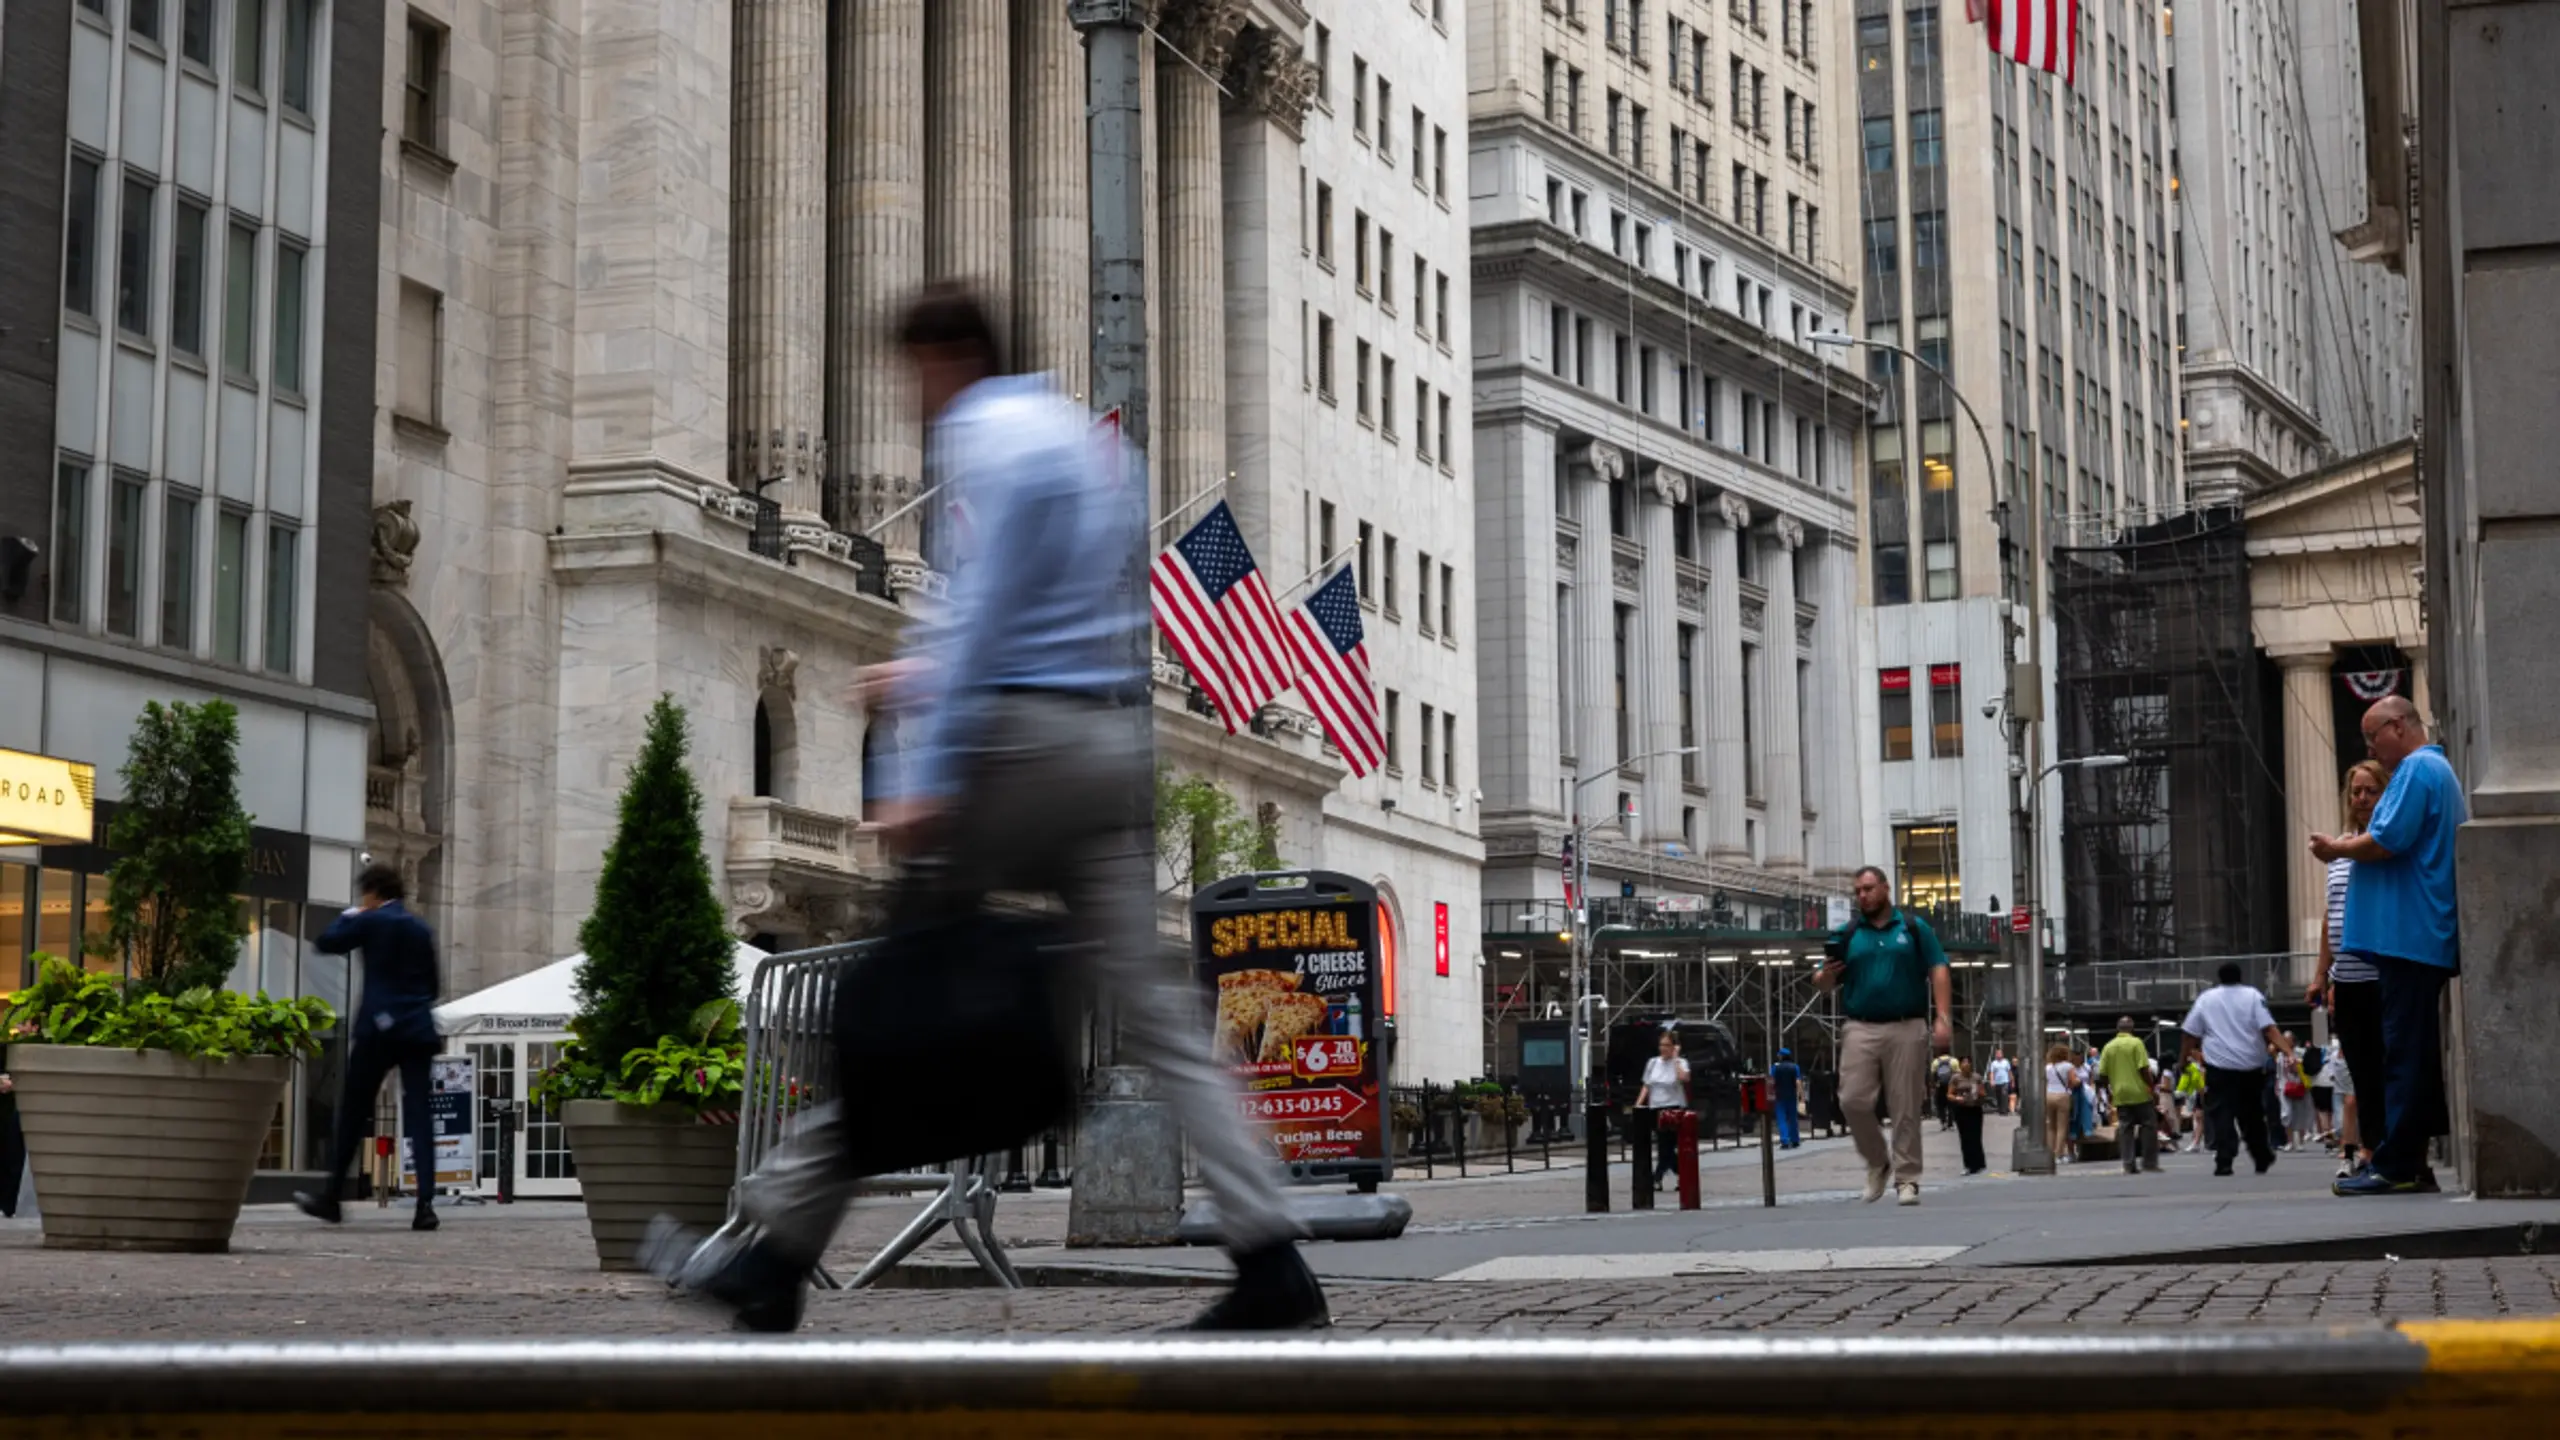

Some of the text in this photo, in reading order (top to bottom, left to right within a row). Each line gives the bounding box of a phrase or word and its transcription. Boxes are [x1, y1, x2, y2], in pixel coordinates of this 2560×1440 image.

[1212, 910, 1358, 957] SPECIAL
[1294, 951, 1366, 974] 2 CHEESE
[1315, 973, 1366, 993] Slices
[497, 1017, 528, 1028] Broad
[531, 1016, 564, 1028] Street
[1239, 1096, 1342, 1116] 12-635-0345
[1274, 1129, 1363, 1145] Cucina Bene
